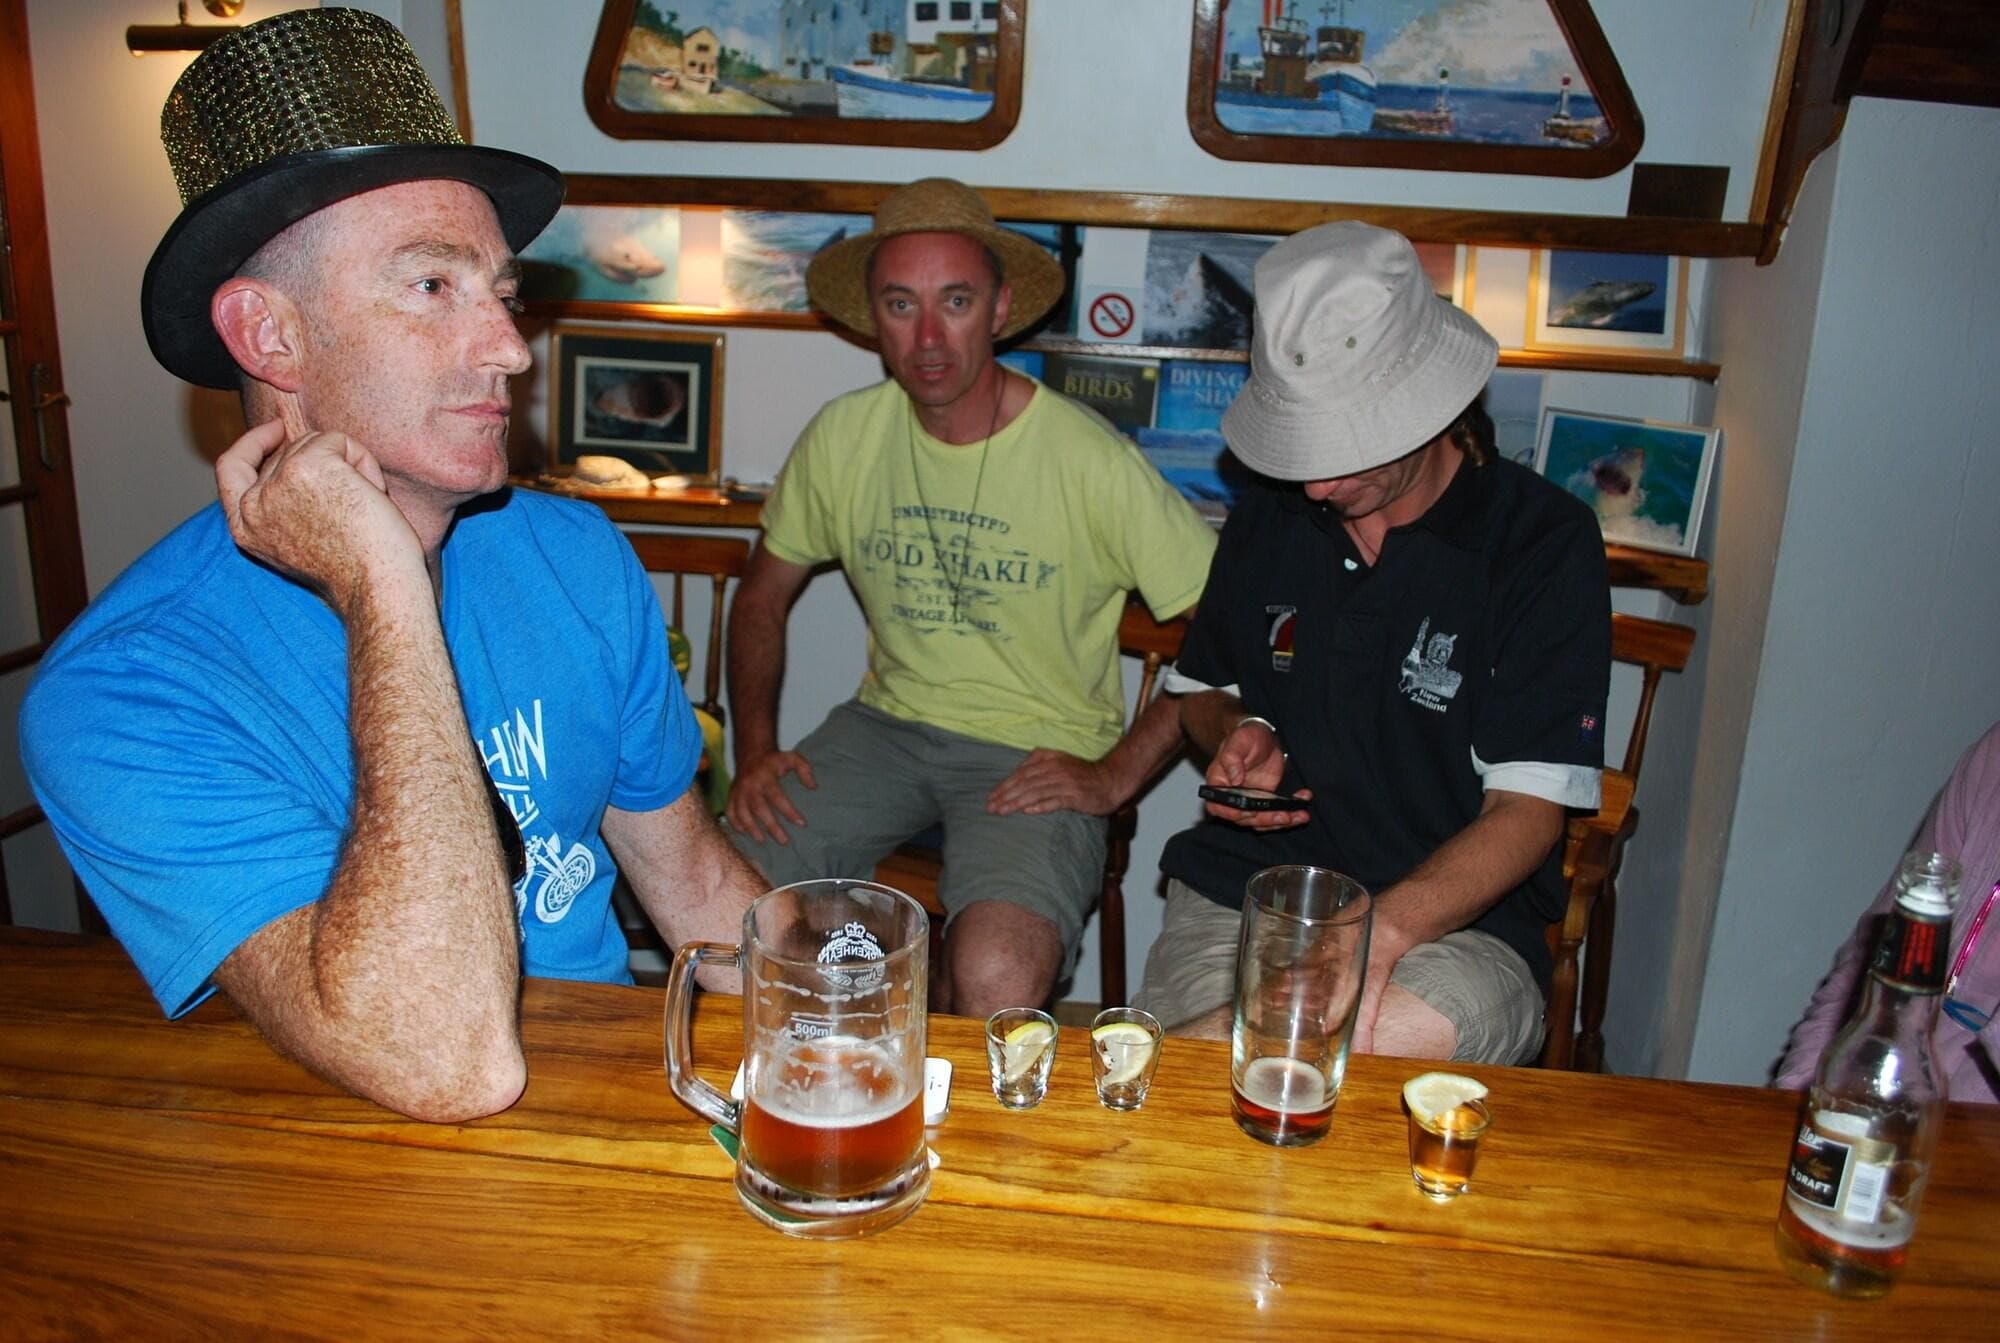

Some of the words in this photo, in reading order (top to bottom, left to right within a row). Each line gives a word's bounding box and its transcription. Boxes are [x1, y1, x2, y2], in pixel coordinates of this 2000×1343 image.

[1064, 375, 1135, 400] BIRDS
[1171, 367, 1245, 387] DIVING
[933, 548, 1029, 583] KHAKI
[1420, 688, 1440, 702] New
[795, 1023, 833, 1038] 500ml
[1796, 1171, 1832, 1193] DRAFT
